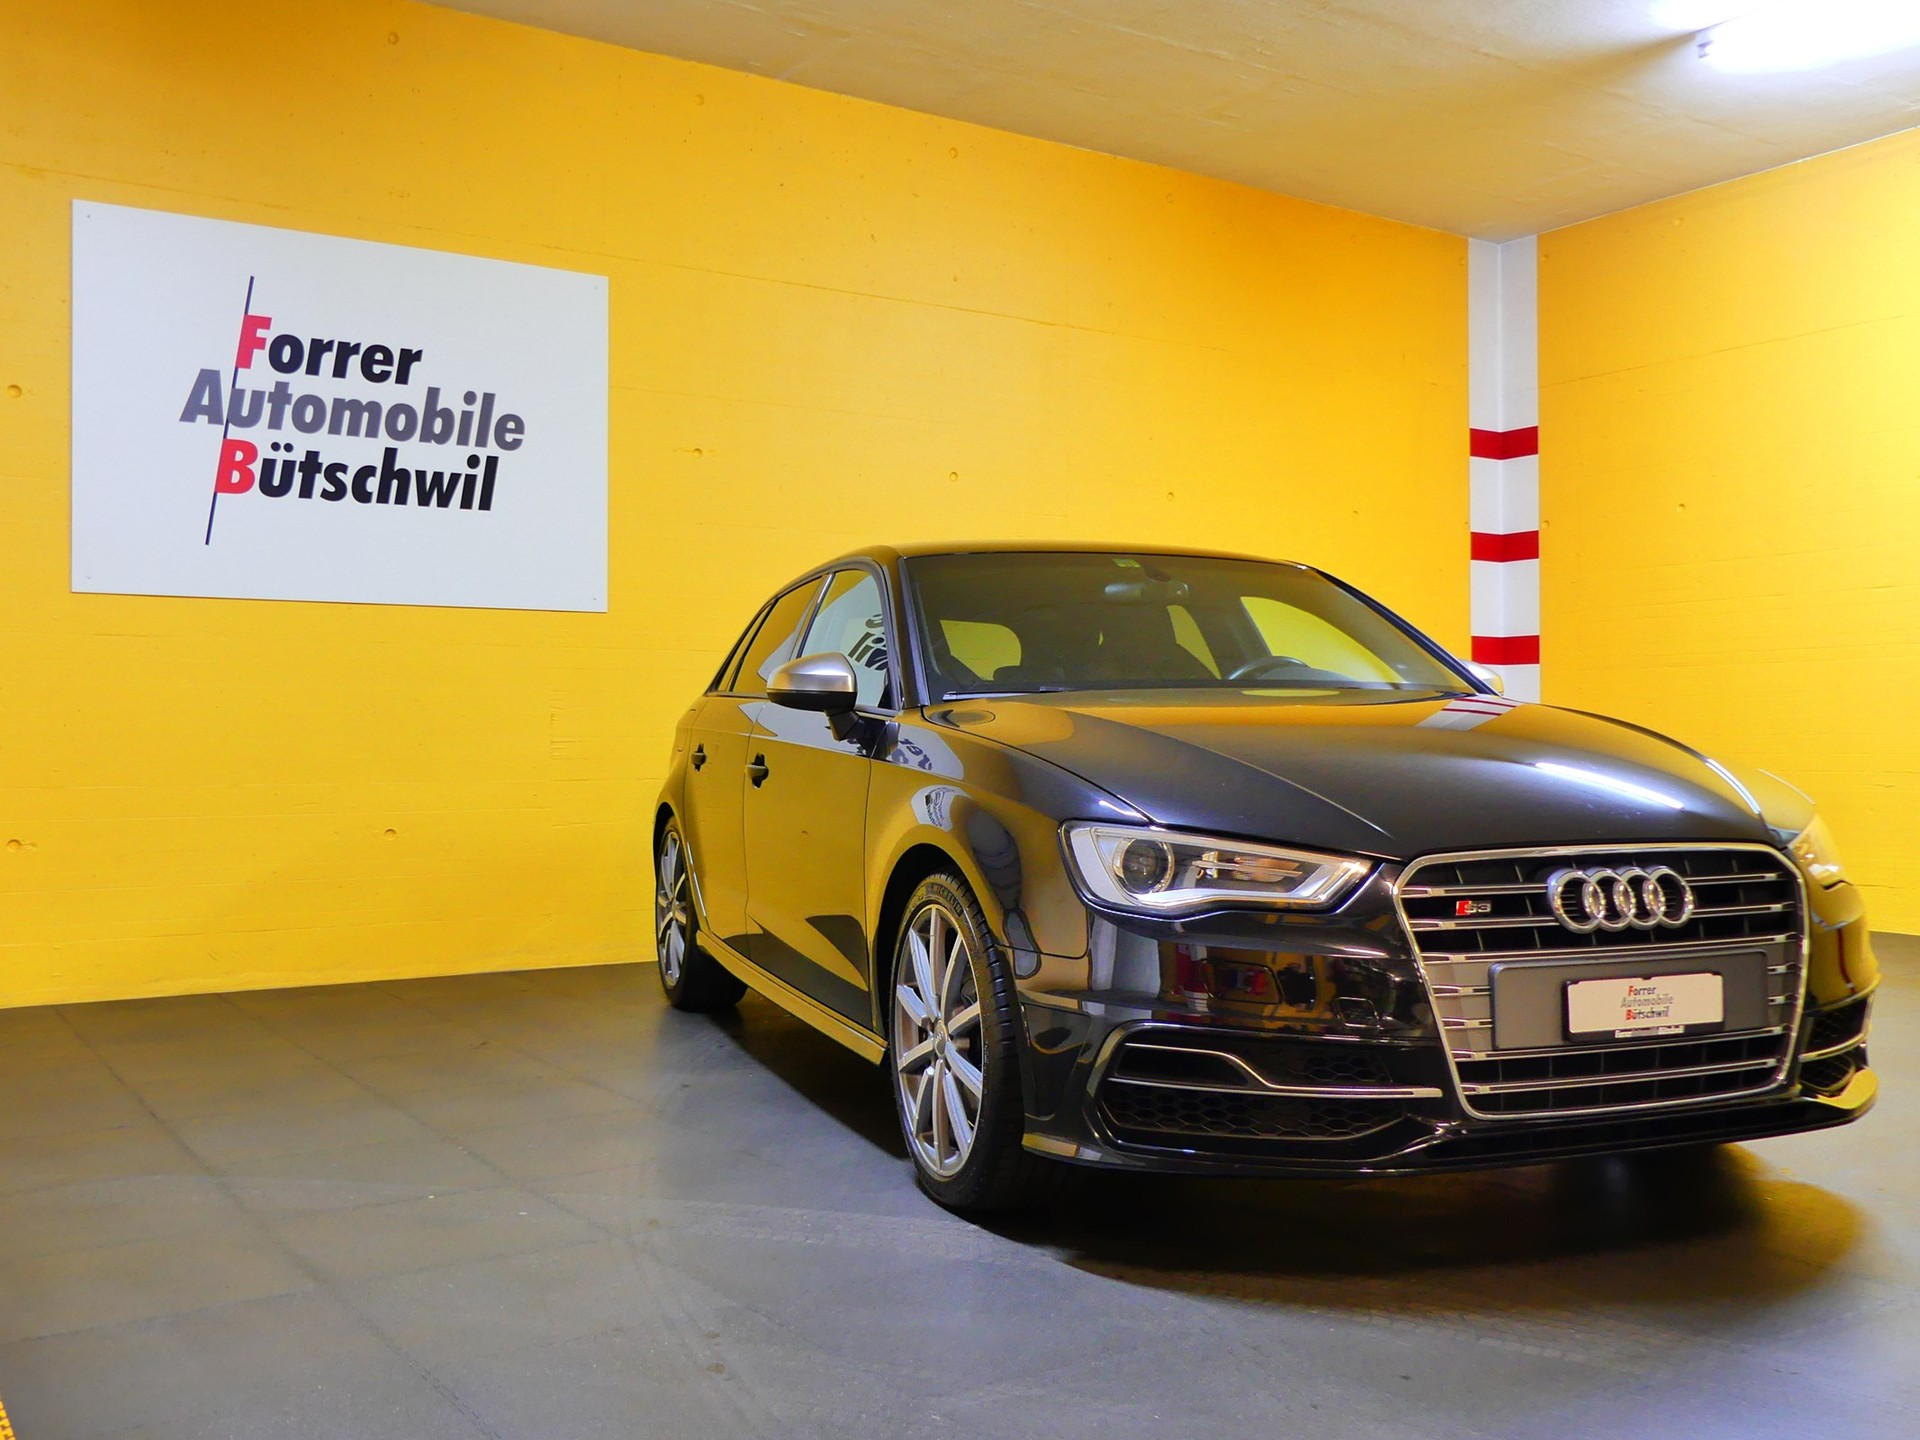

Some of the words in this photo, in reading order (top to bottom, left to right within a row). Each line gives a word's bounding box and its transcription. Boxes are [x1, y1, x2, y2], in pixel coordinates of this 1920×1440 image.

[235, 314, 423, 385] Forrer
[178, 368, 526, 452] Automobile
[214, 438, 499, 512] Bütschwil
[1627, 985, 1656, 996] Forrer
